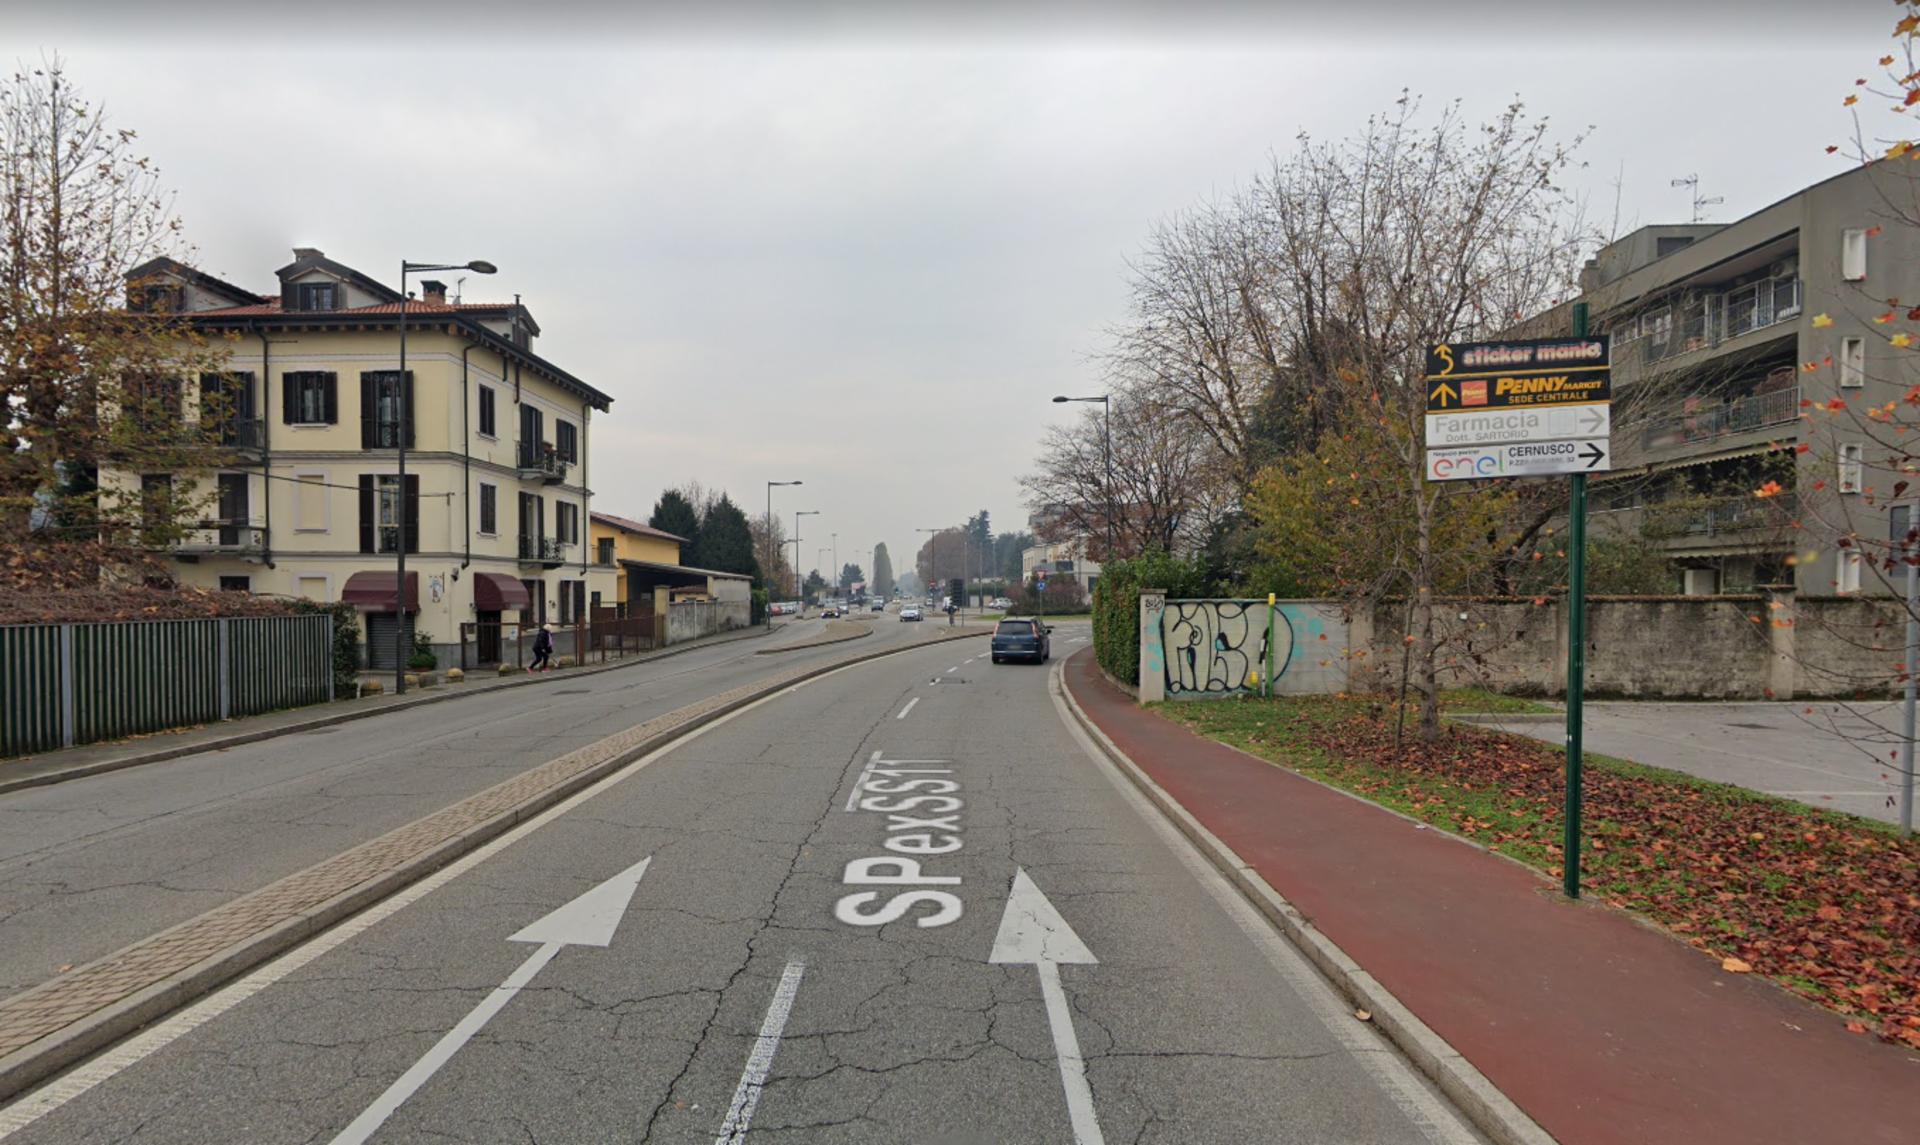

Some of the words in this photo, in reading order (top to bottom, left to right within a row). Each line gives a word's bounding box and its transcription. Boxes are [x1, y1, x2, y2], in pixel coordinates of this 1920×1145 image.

[1463, 347, 1532, 366] sticker
[1495, 376, 1569, 396] PENNY
[1563, 380, 1602, 390] MARKET
[1508, 393, 1534, 404] SEDE
[1536, 390, 1589, 402] CENTRALE
[1435, 411, 1539, 433] Farmacia
[1446, 434, 1472, 442] Dott.
[1475, 430, 1529, 441] SARTORIO
[1508, 443, 1575, 457] CERNUSCO
[1433, 449, 1504, 477] enel
